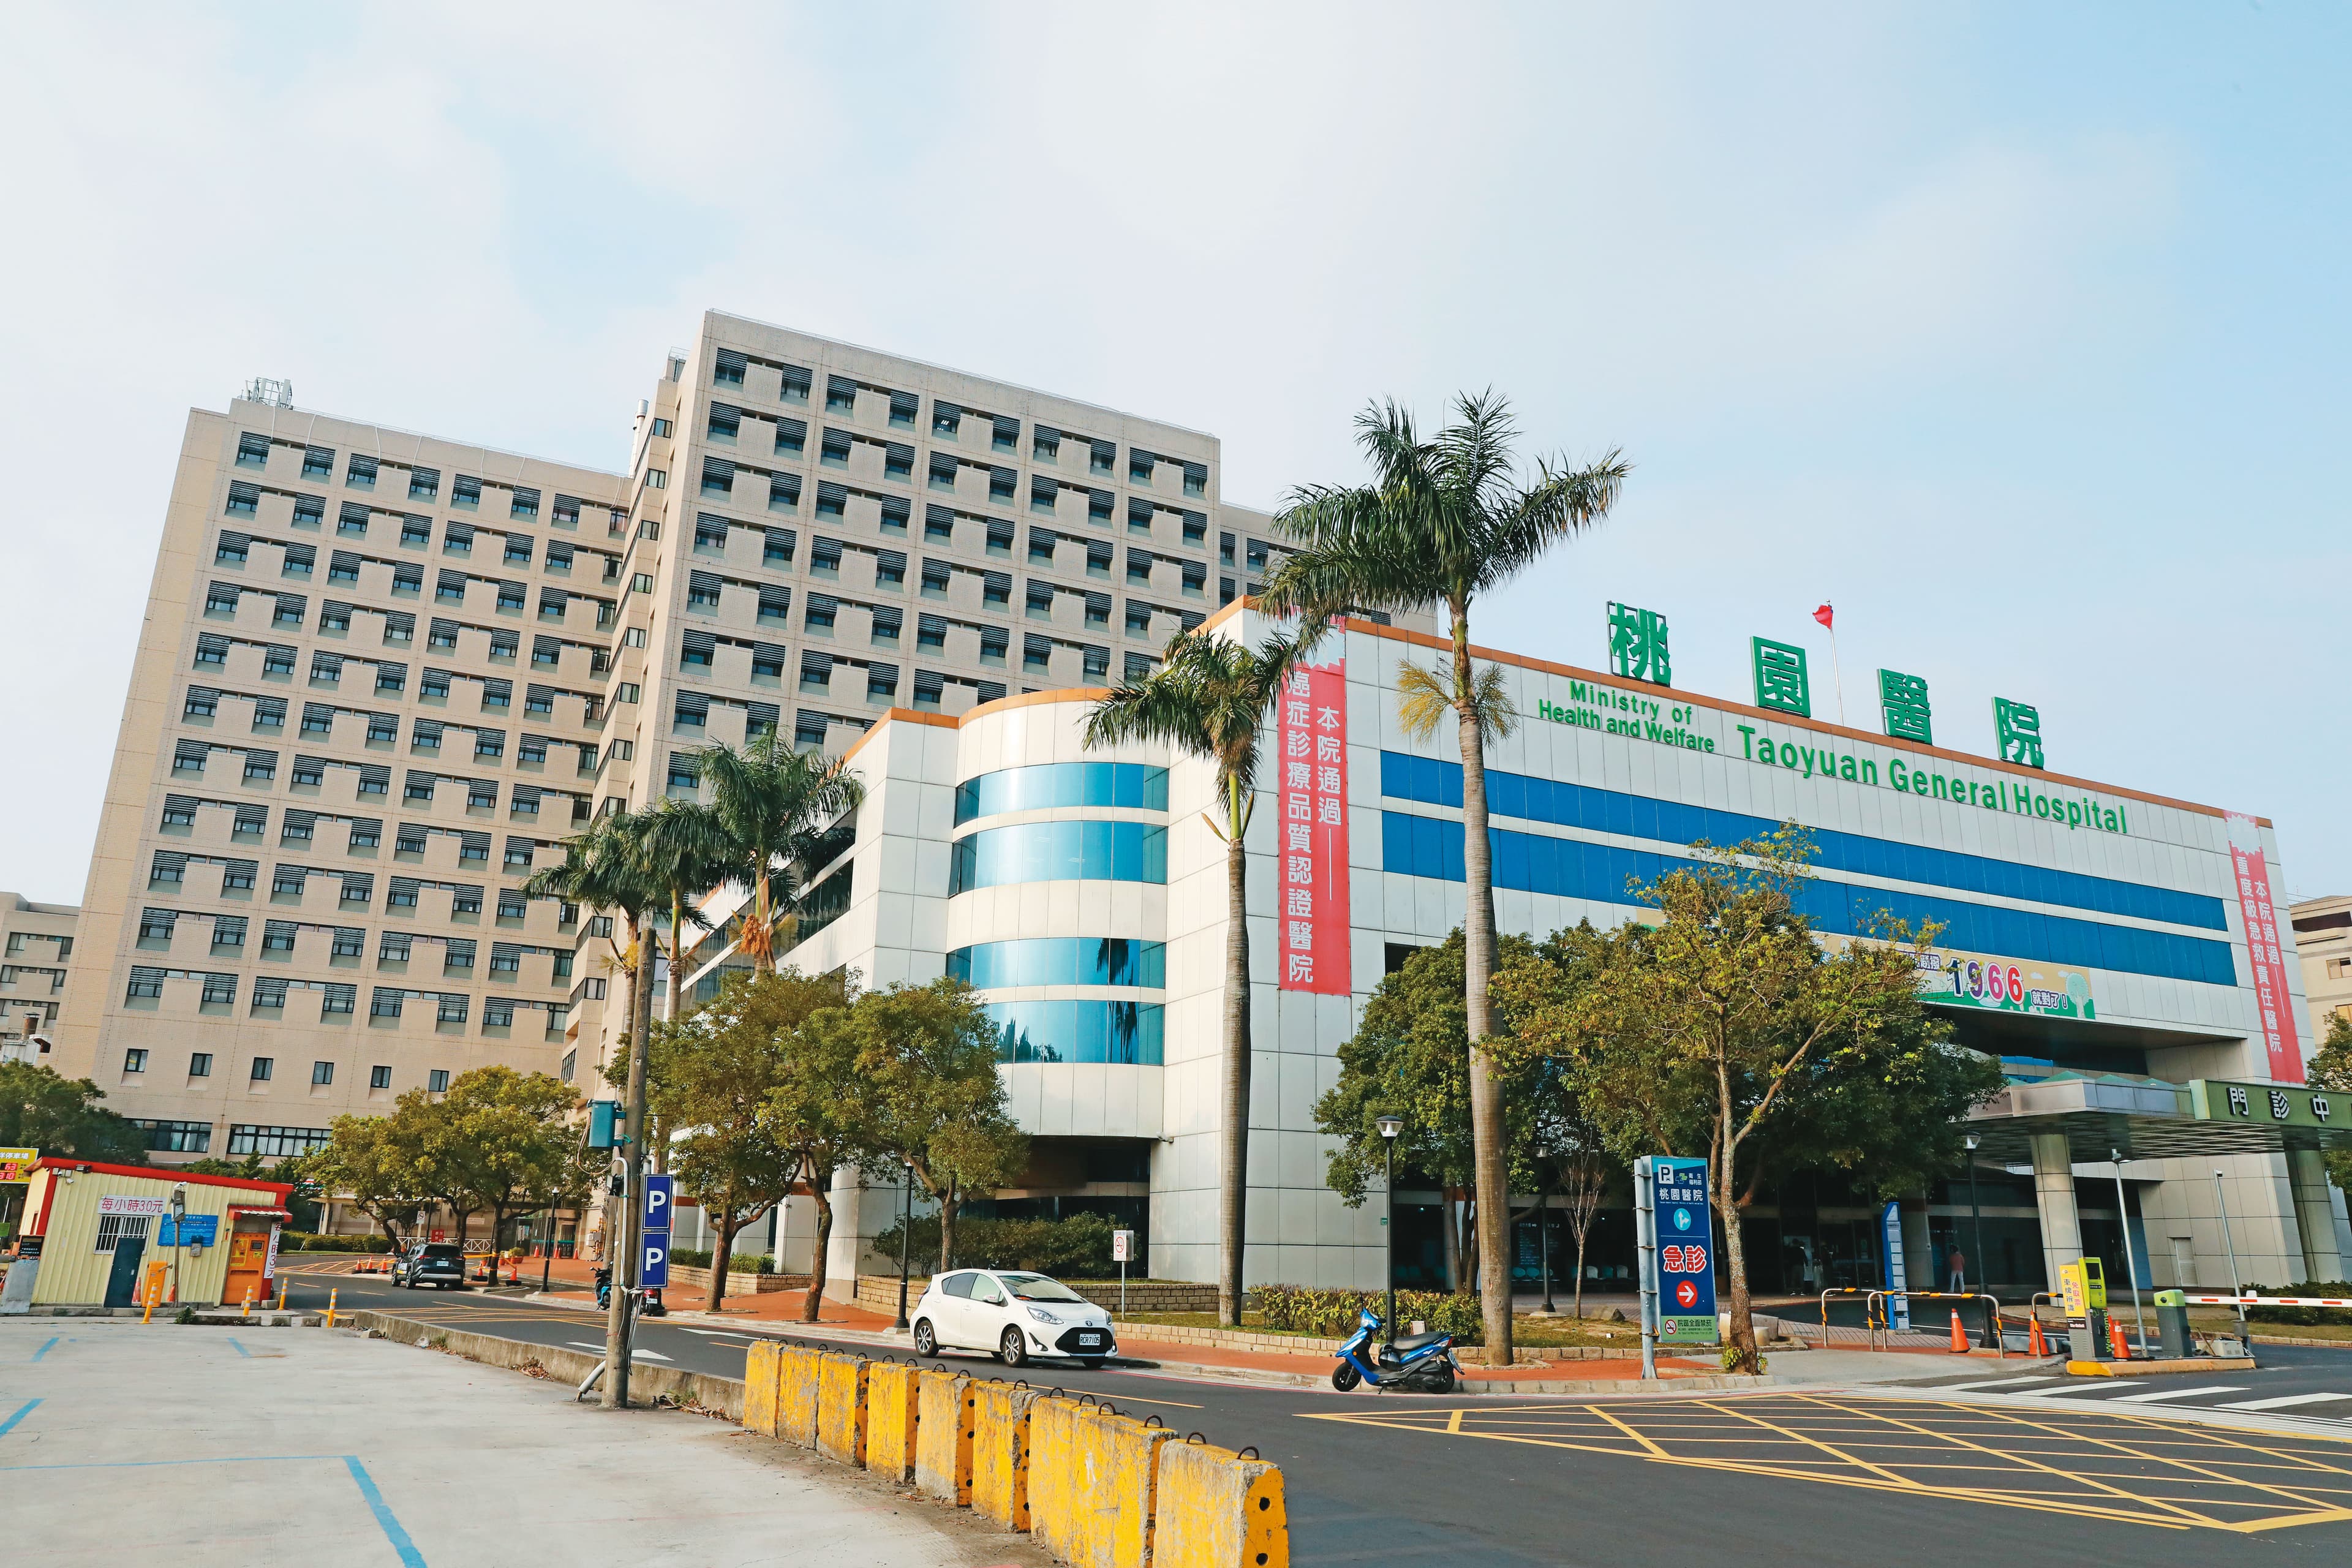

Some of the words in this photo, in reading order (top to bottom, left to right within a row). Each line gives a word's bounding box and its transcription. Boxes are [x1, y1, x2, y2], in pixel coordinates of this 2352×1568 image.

[1570, 680, 1659, 721] Ministry
[1672, 706, 1692, 725] of
[1608, 601, 2044, 768] 桃園醫院
[1539, 699, 1600, 729] Health
[1607, 717, 1640, 737] and
[1644, 720, 1714, 752] Welfare
[1317, 706, 1341, 826] 本院通過
[1736, 725, 1878, 785] Taoyuan
[1889, 758, 2007, 811] General
[2013, 783, 2127, 834] Hospital
[1287, 671, 1313, 983] 癌症診療品質認證醫院
[2236, 856, 2283, 1053] 重度級急救責任醫院
[1946, 957, 2025, 1005] 1966
[1659, 1188, 1703, 1201] 桃園醫院
[1660, 1166, 1670, 1182] P
[102, 1197, 164, 1213] 每小時30元
[648, 1190, 666, 1214] P
[645, 1248, 664, 1271] P
[1663, 1245, 1707, 1273] 急診
